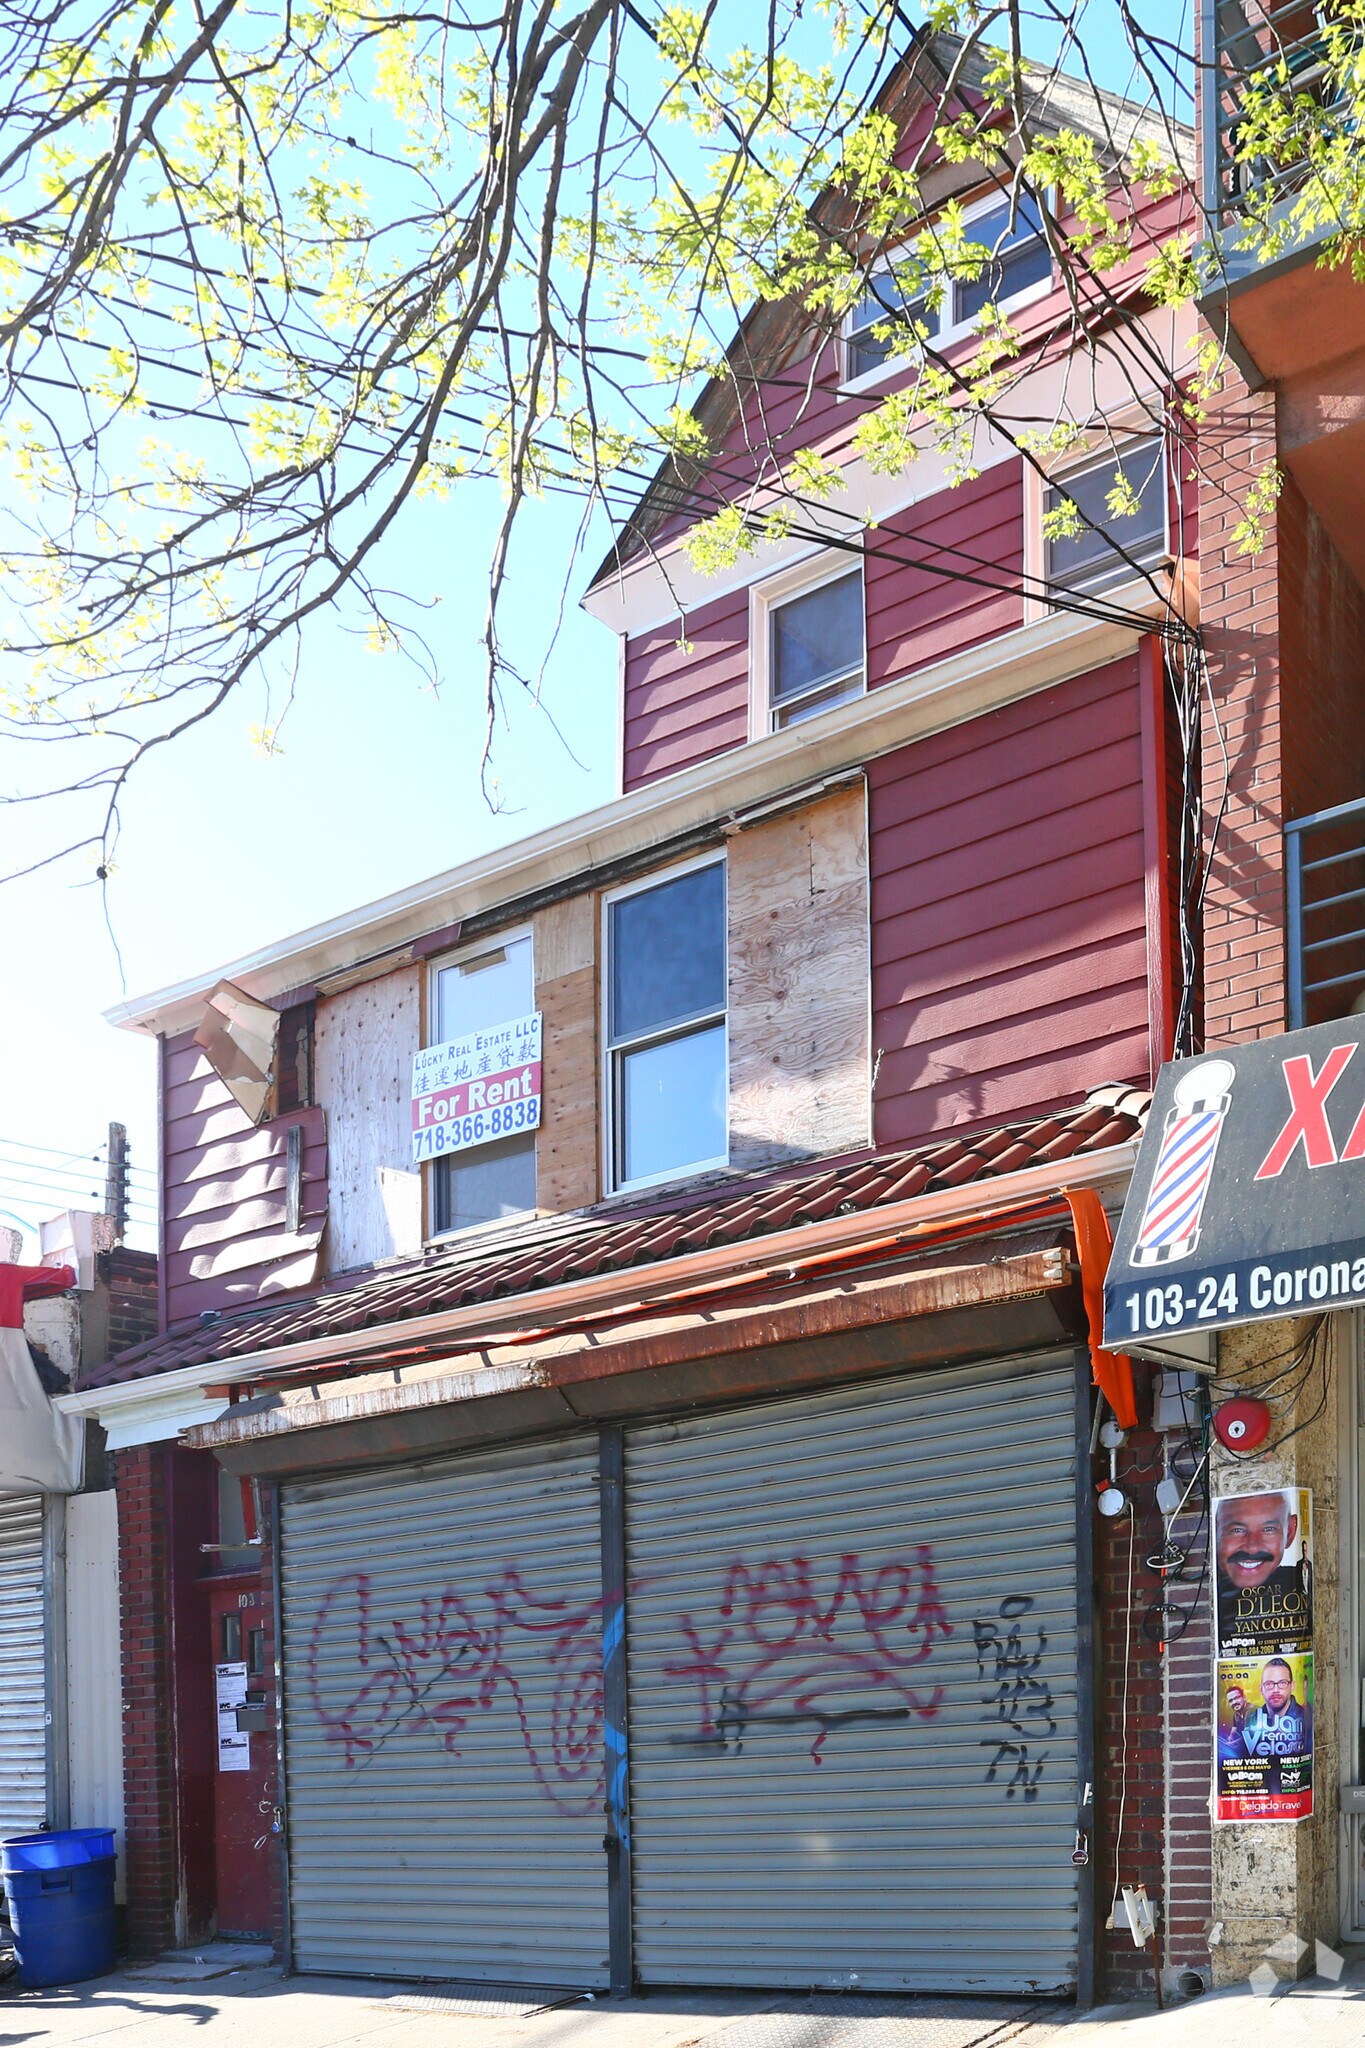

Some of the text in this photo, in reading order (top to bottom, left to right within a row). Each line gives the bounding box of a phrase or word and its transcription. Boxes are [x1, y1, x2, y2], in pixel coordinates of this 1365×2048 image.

[415, 1019, 538, 1071] LUCKY REAL ESTATE LLC
[418, 1067, 532, 1127] For Rent
[414, 1098, 538, 1159] 718-366-8838
[1126, 1257, 1365, 1332] 103-24 Corona
[1242, 1584, 1281, 1598] OSCAR
[1235, 1620, 1259, 1633] YAN
[1250, 1708, 1302, 1732] Juan
